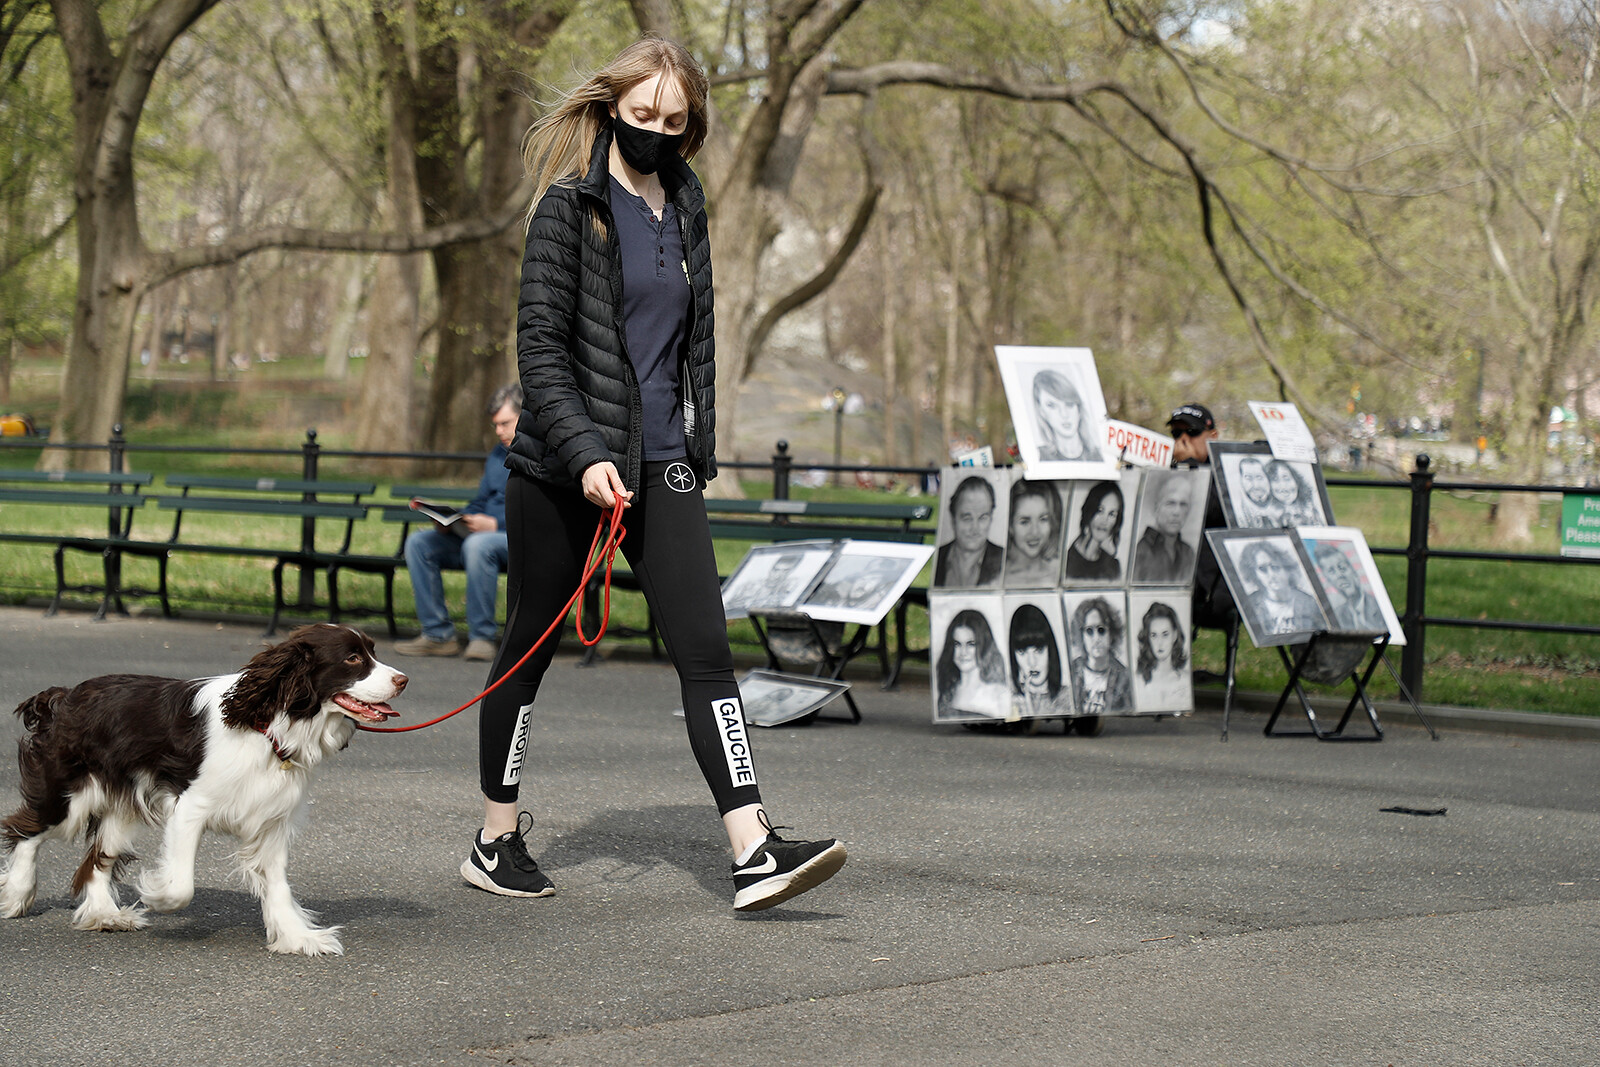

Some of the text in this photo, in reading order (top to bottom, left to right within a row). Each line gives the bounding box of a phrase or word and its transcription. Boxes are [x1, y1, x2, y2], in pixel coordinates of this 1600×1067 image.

[1107, 426, 1171, 467] PORTRAIT
[1565, 527, 1600, 543] Pleas
[509, 710, 531, 778] DROITE
[720, 702, 753, 783] GAUCHE
